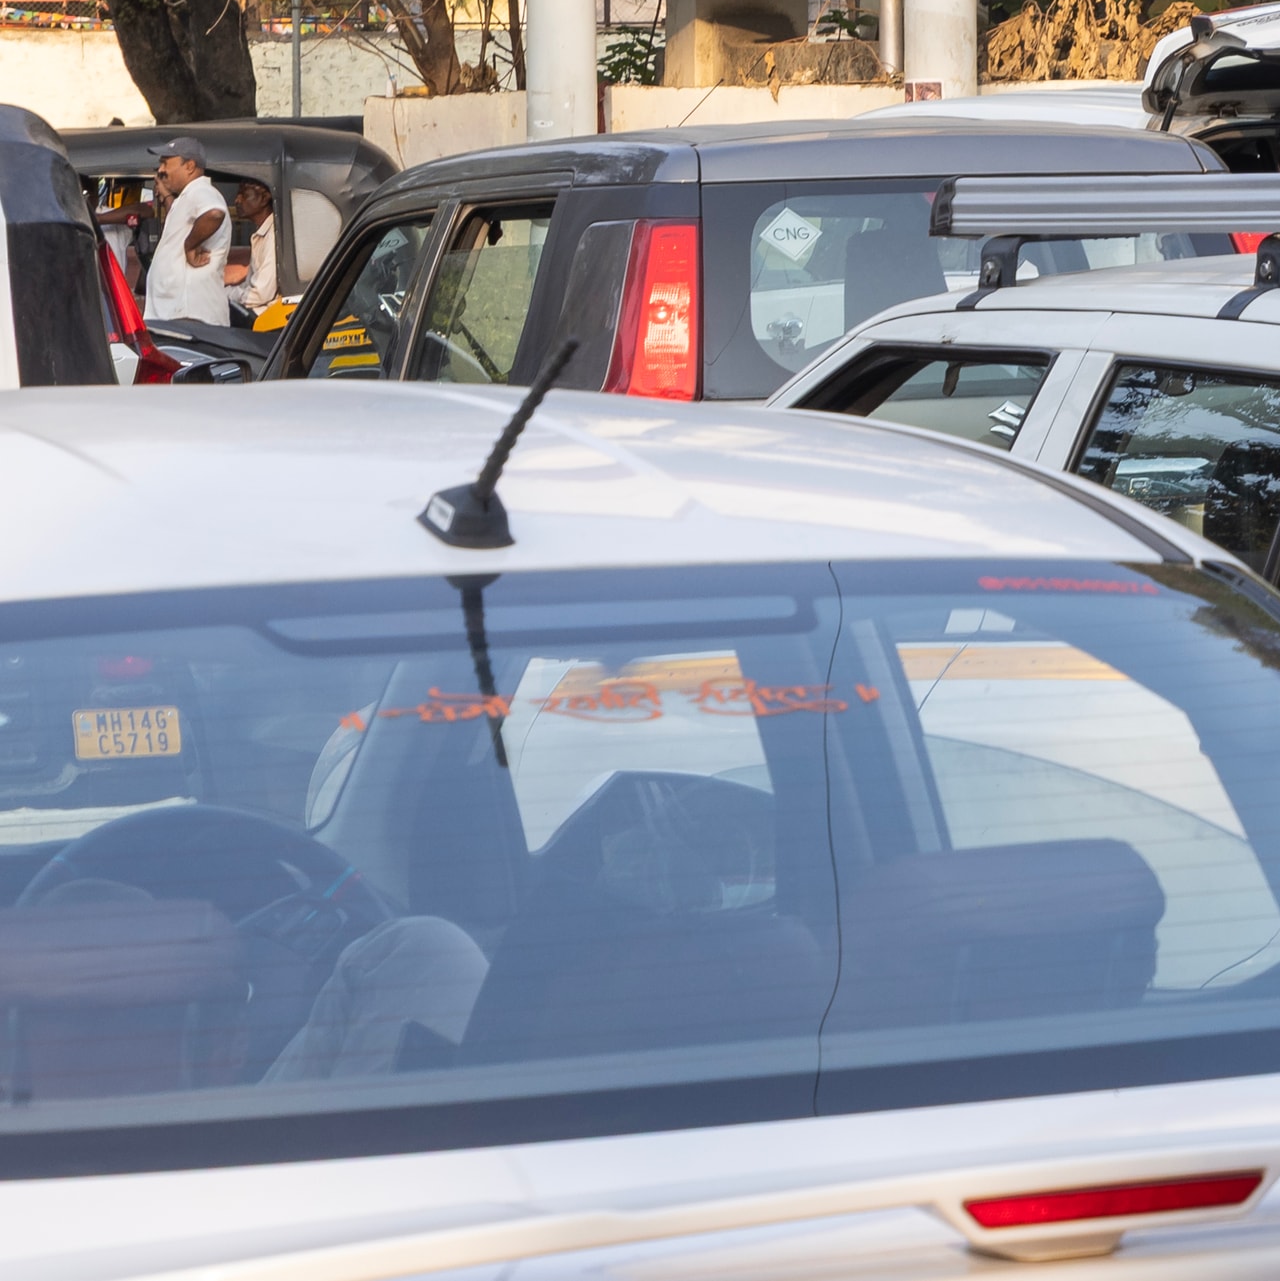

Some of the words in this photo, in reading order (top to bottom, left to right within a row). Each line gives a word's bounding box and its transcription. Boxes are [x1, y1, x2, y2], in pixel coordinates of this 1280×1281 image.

[773, 227, 810, 241] CNG
[96, 710, 167, 733] MH14G
[98, 732, 168, 754] C5719
